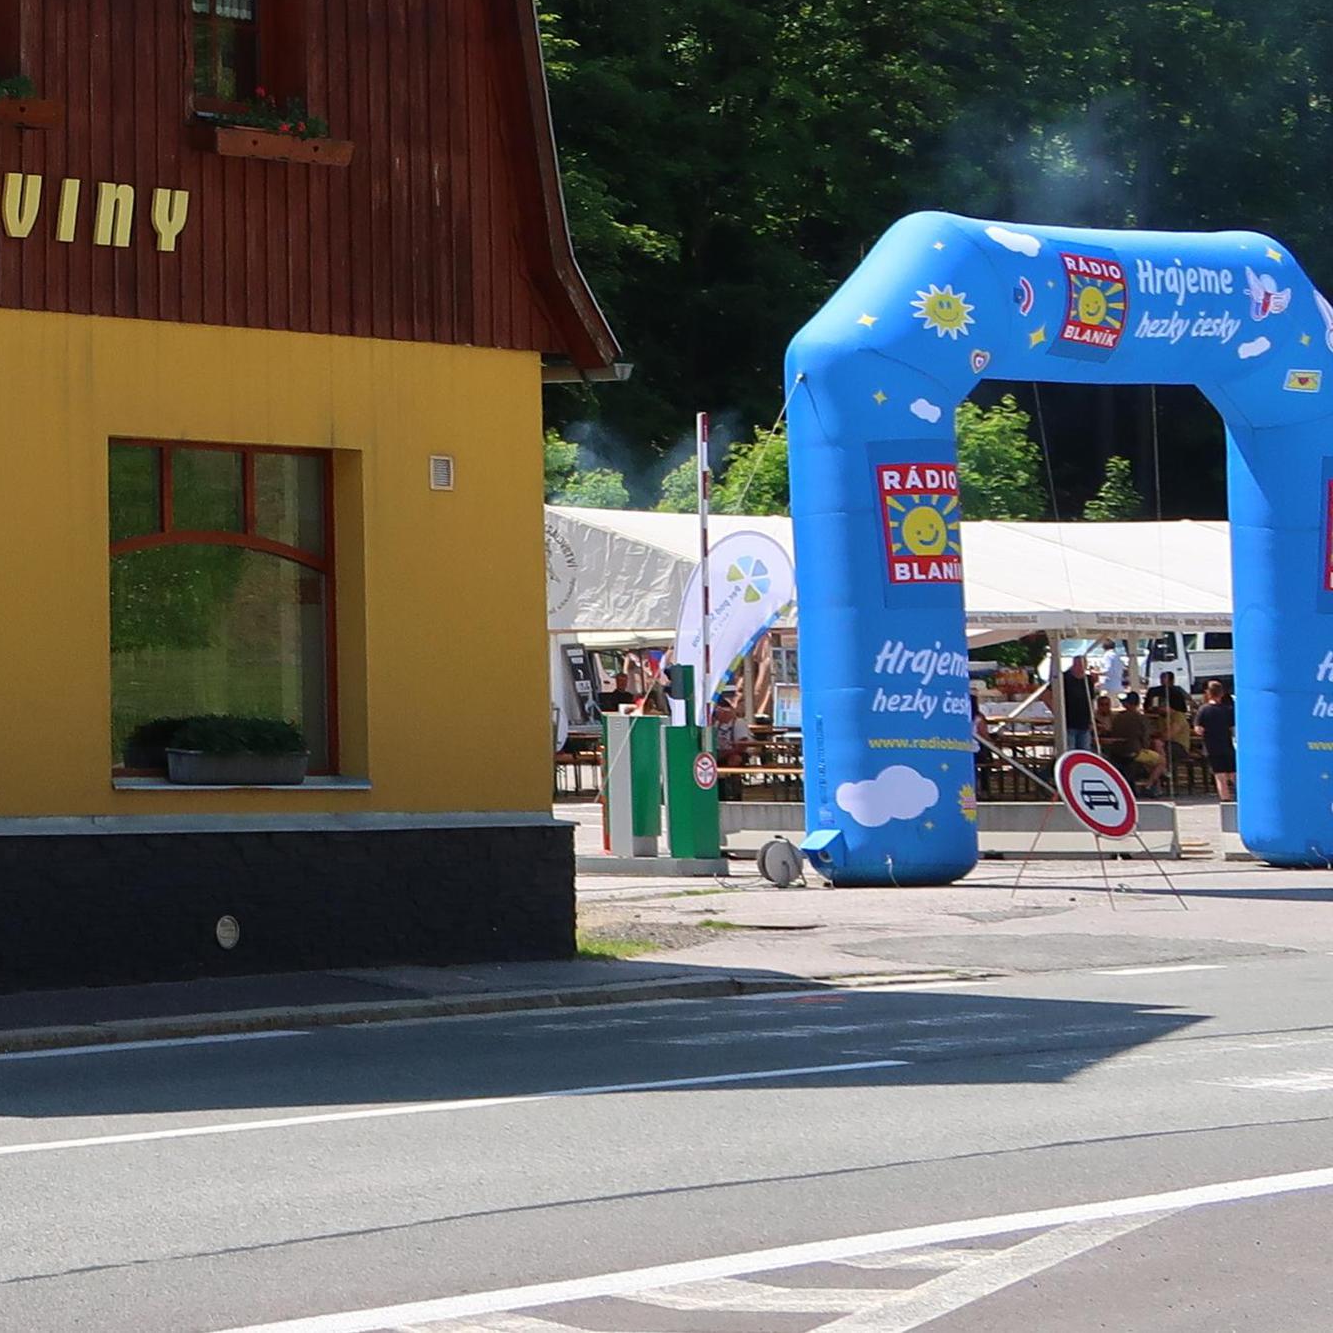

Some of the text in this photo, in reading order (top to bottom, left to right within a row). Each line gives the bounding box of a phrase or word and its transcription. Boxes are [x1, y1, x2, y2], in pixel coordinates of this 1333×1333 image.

[1063, 255, 1122, 279] RÁDIO
[1135, 257, 1233, 306] Hrajeme
[1063, 324, 1119, 347] BLANÍK
[1135, 311, 1241, 345] hezky česky
[882, 465, 958, 490] RÁDIO
[894, 558, 963, 581] BLANÍ
[872, 687, 938, 719] hezky
